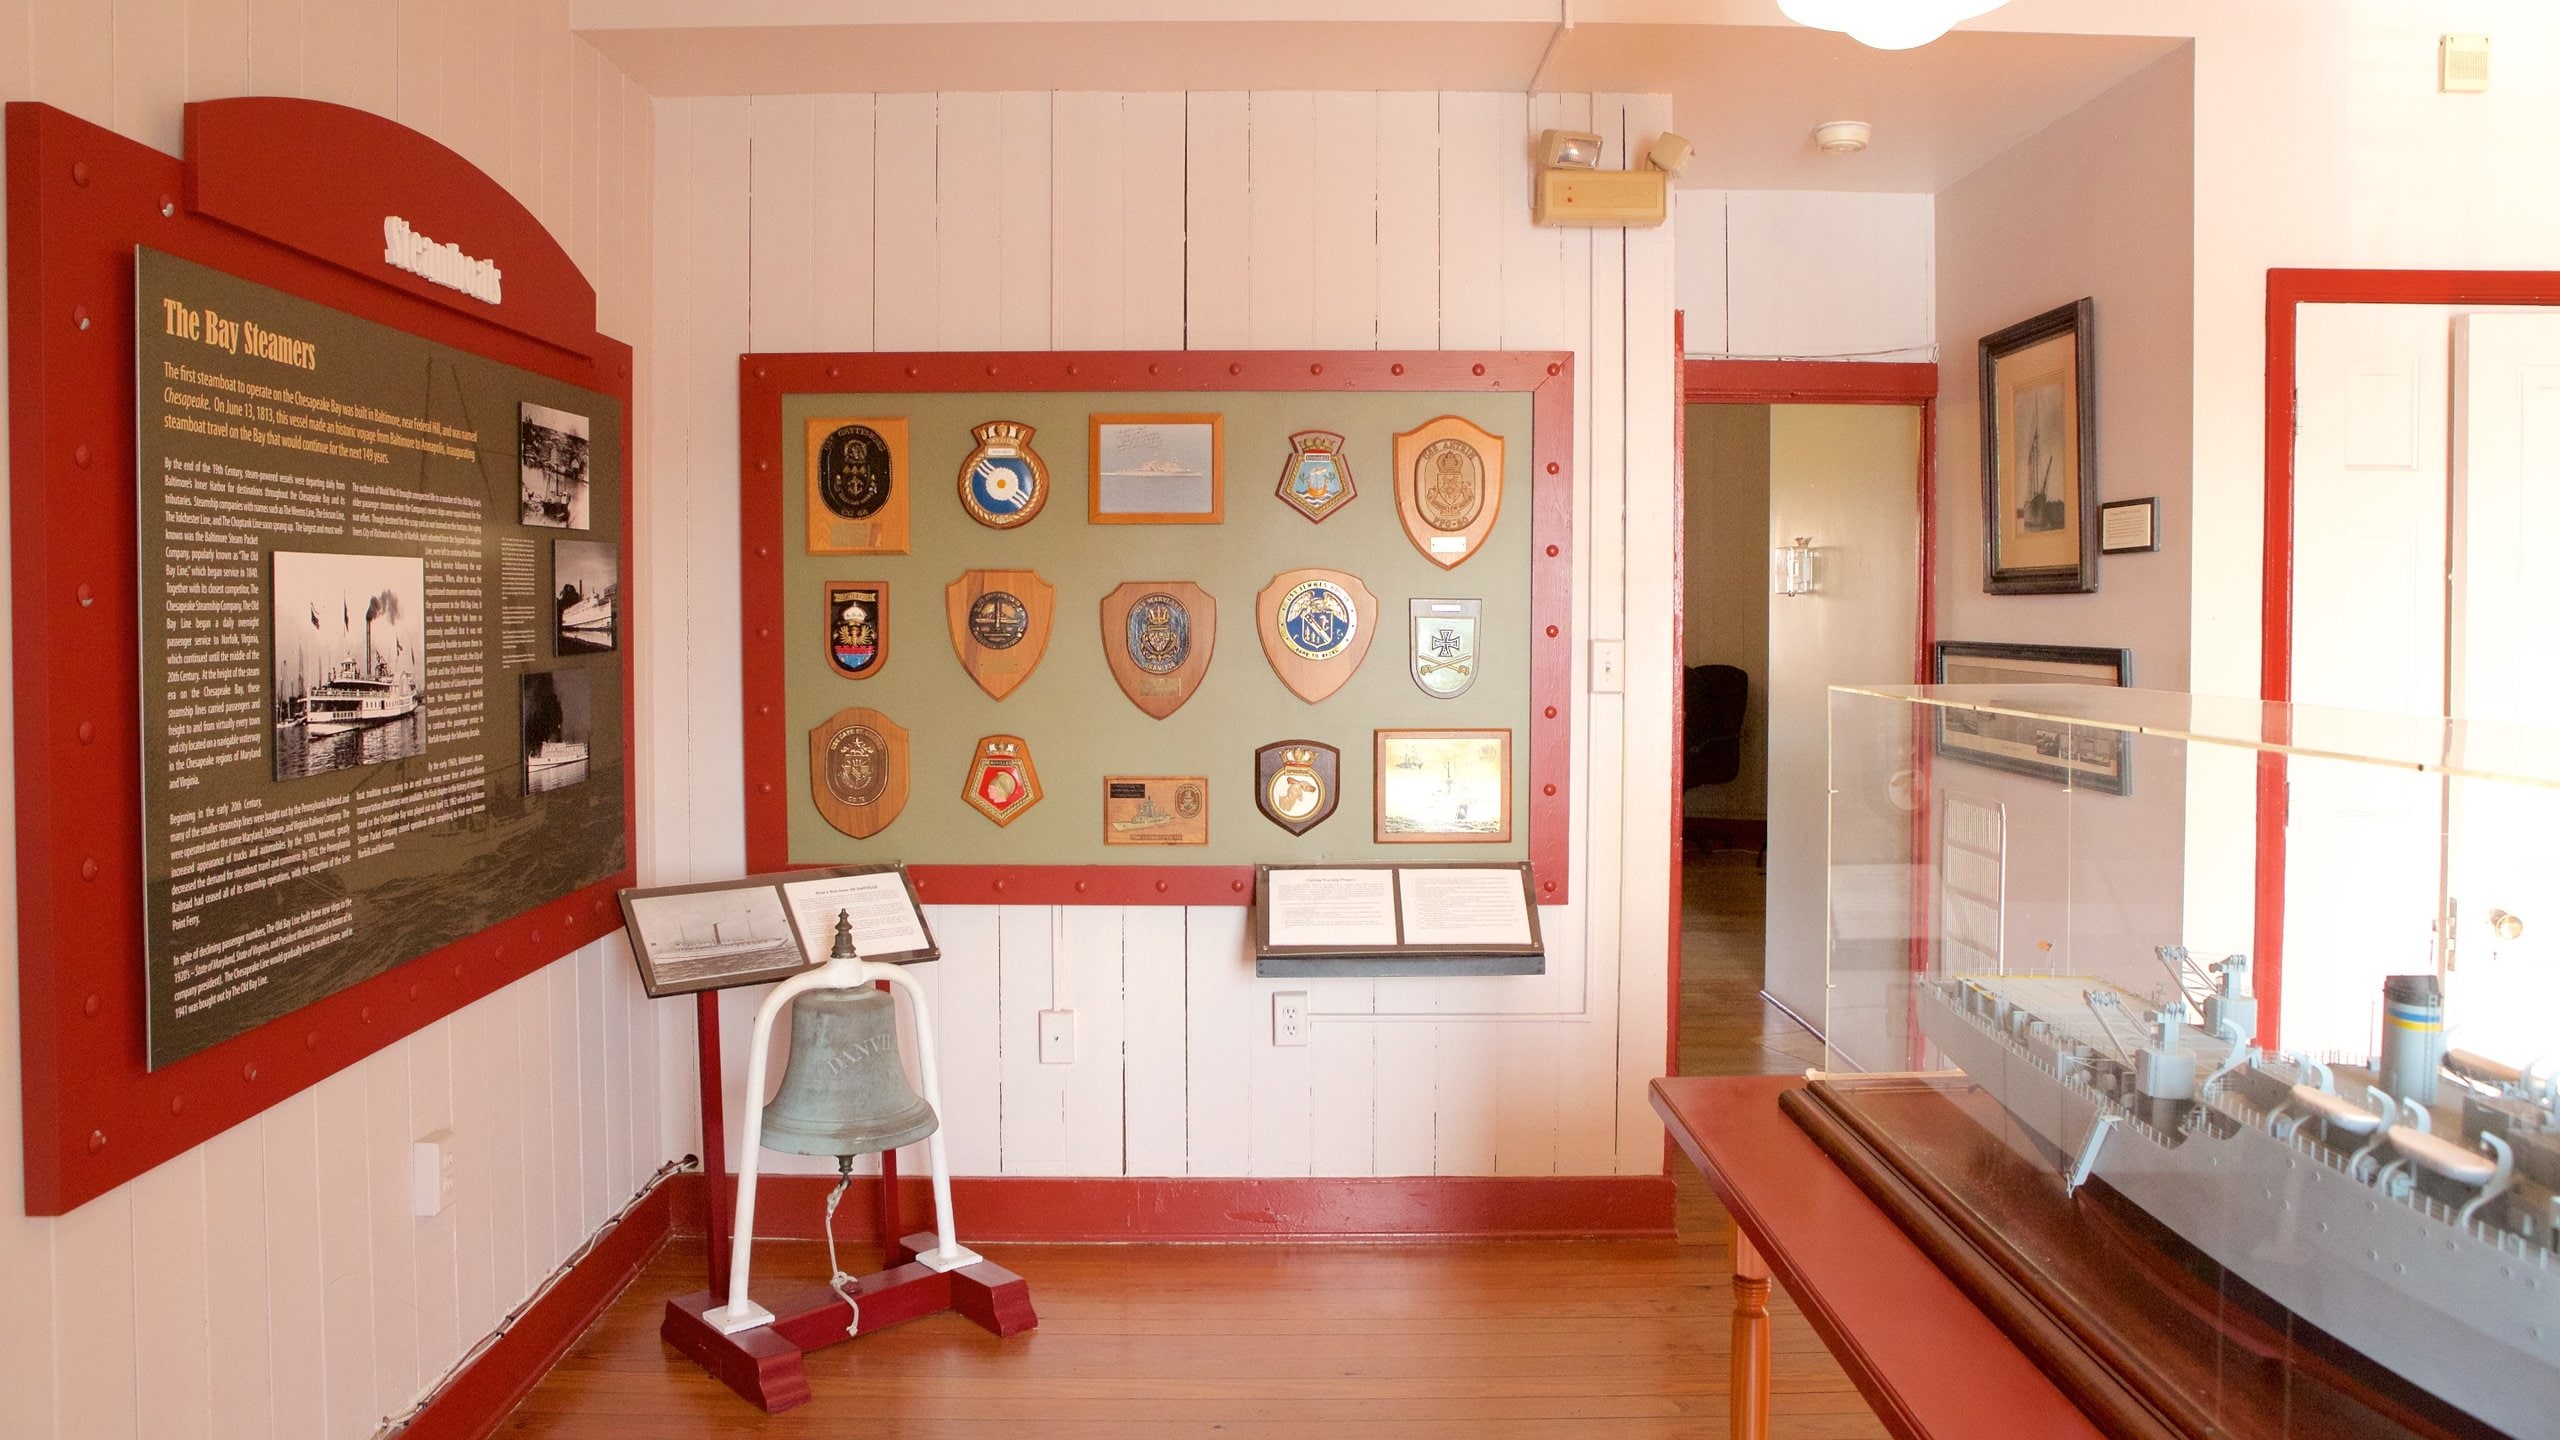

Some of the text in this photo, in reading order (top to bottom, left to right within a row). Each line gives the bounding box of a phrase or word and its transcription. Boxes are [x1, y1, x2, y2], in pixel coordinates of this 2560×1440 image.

[163, 298, 316, 371] The Bay Steamers
[164, 361, 477, 442] The first steamboat to operate on the Chesapeake Bay was built in Baltimore, near Federal Hill, and was named
[164, 387, 211, 410] Chesapeake.
[214, 396, 225, 413] On
[226, 399, 243, 416] June
[244, 403, 255, 421] 13,
[256, 406, 275, 424] 1813,
[276, 409, 289, 425] this
[288, 414, 308, 428] vessel
[308, 418, 326, 432] made
[326, 422, 335, 434] an
[334, 420, 356, 438] historic
[356, 429, 376, 444] voyage
[376, 429, 390, 444] from
[389, 432, 415, 449] Baltimore
[164, 414, 389, 465] steamboat travel on the Bay that would continue for the next 149 years.
[166, 616, 259, 631] Bay Line began a daily overnight
[167, 634, 259, 649] passenger service to Norfolk, Virginia,
[168, 682, 260, 700] era on the Chesapeake Bay, these
[170, 798, 262, 826] Beginning in the early 20th Century,
